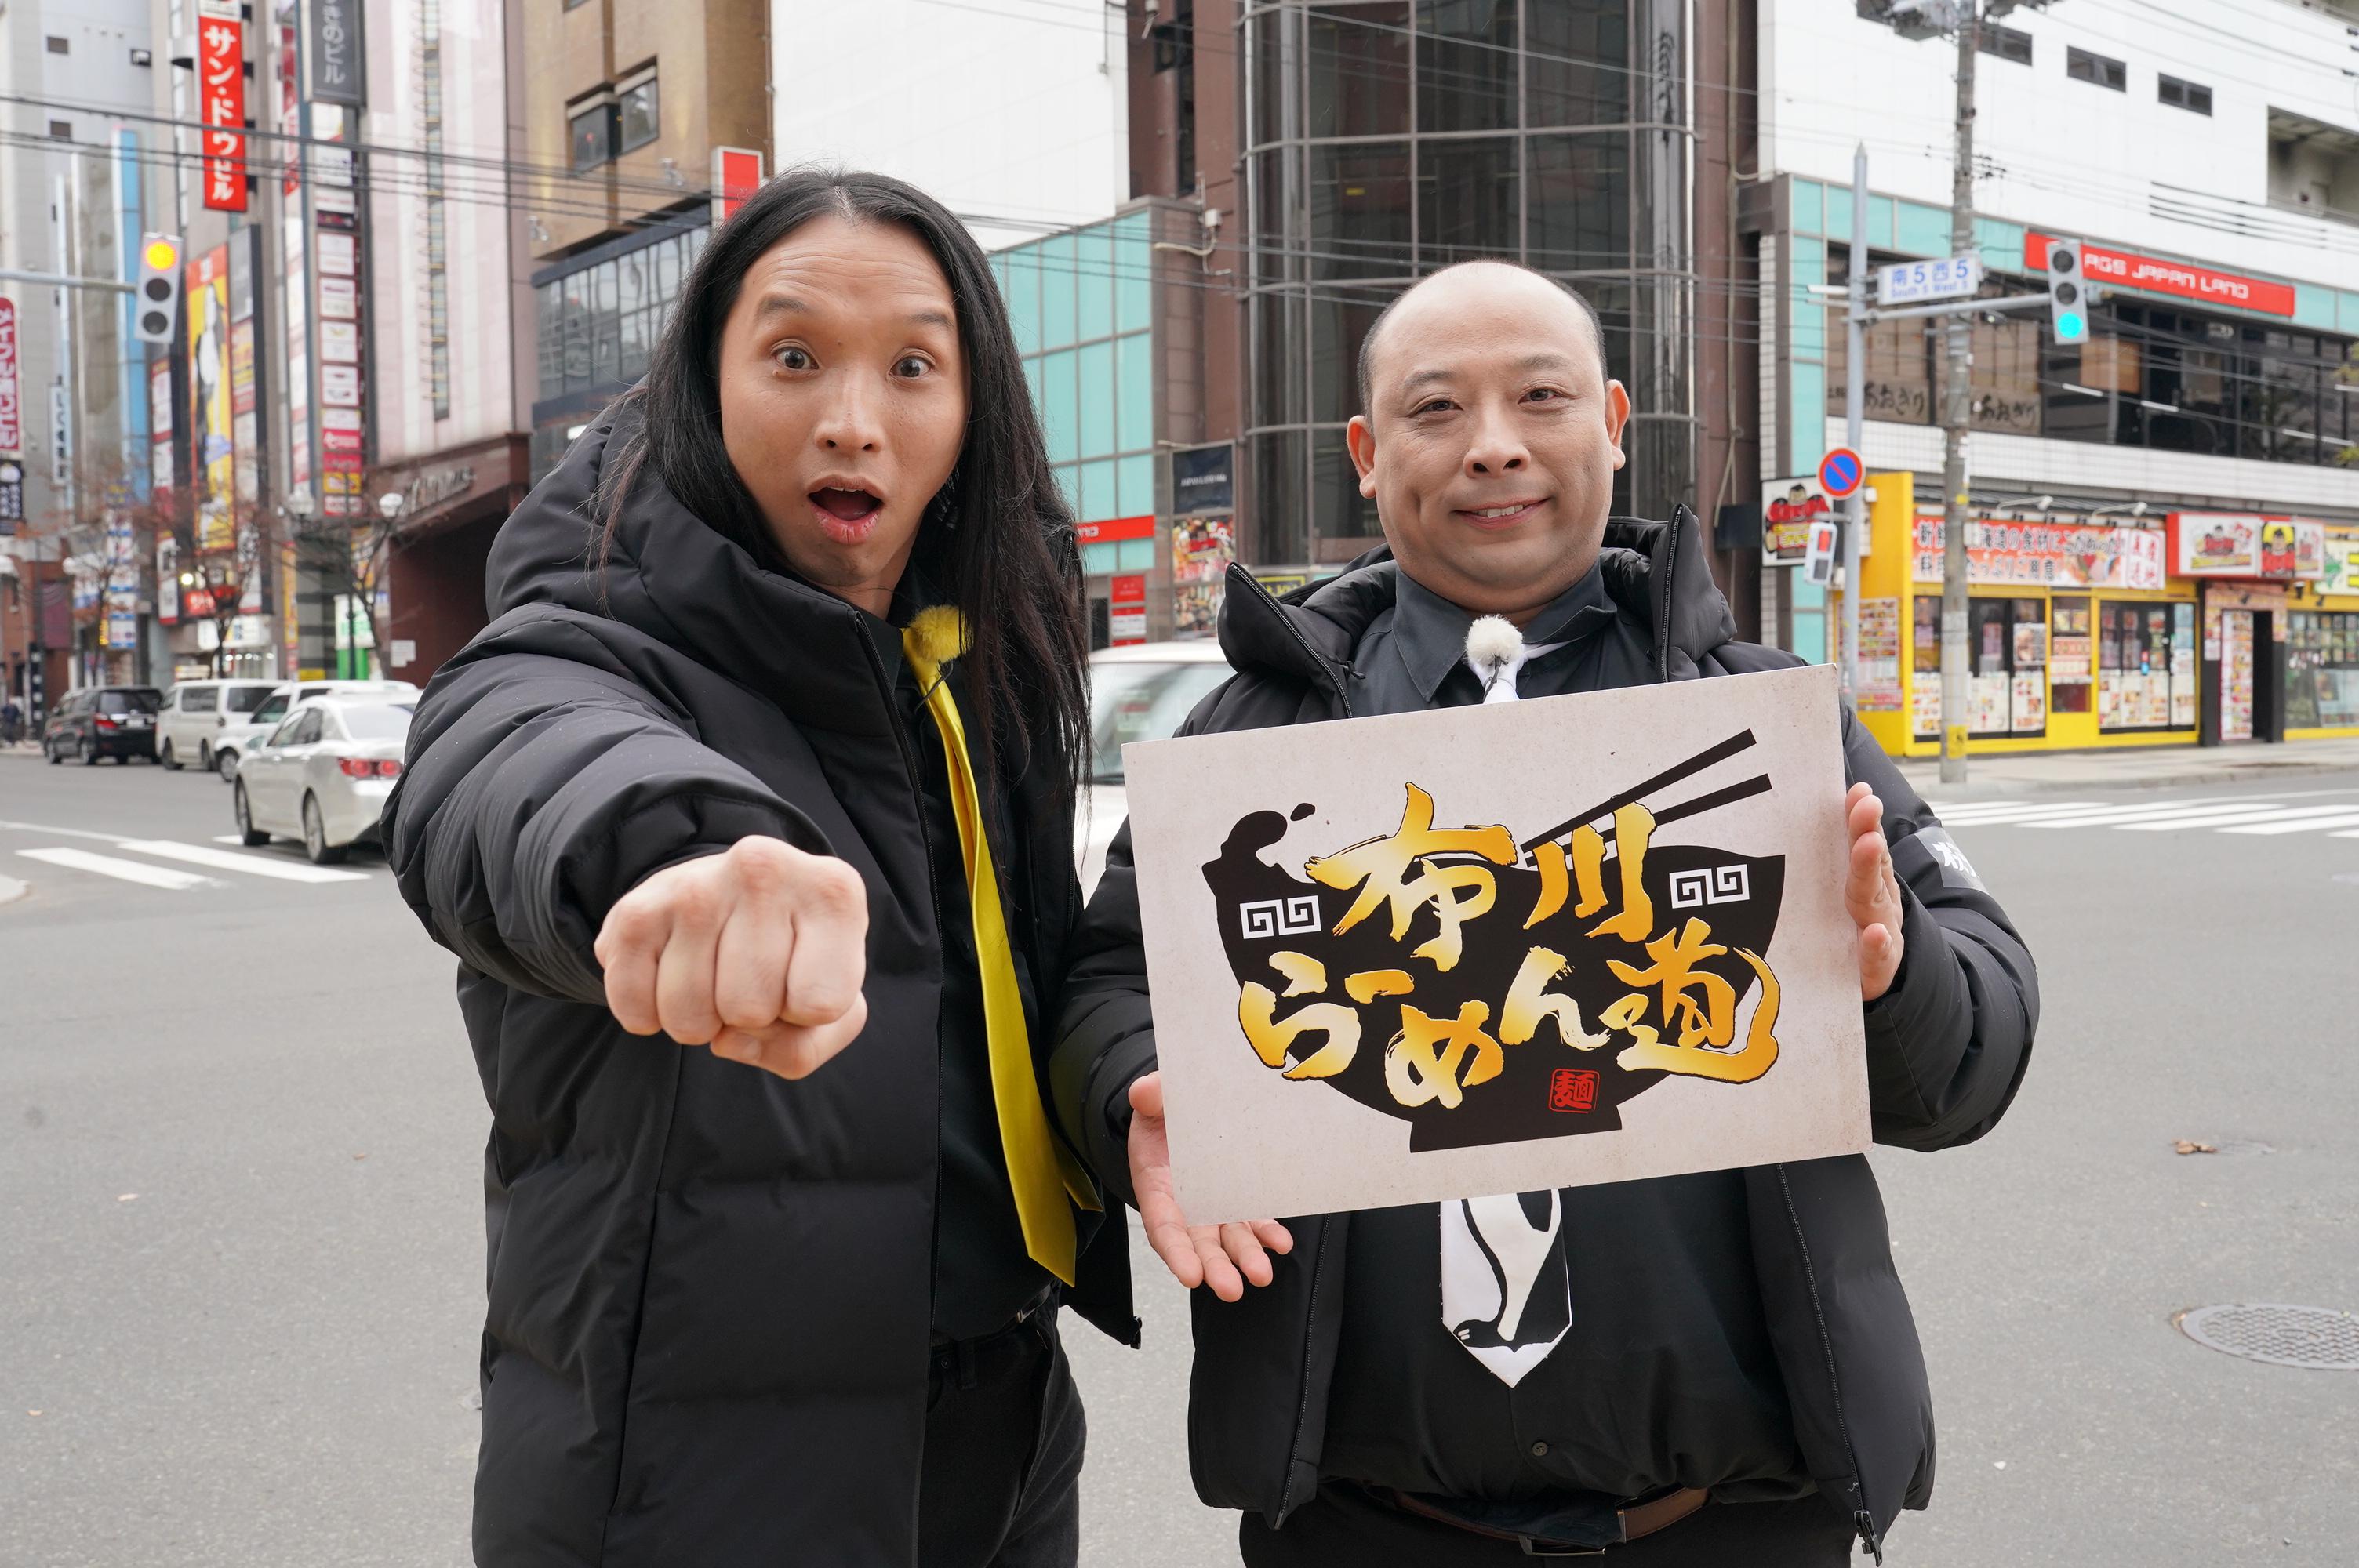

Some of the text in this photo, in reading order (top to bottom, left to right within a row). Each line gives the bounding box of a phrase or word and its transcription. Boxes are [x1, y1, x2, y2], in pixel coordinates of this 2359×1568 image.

[2132, 263, 2196, 289] JAPAN
[2200, 275, 2249, 299] LAND
[1302, 781, 1658, 972] 布川
[1238, 916, 1781, 1109] らーめん道
